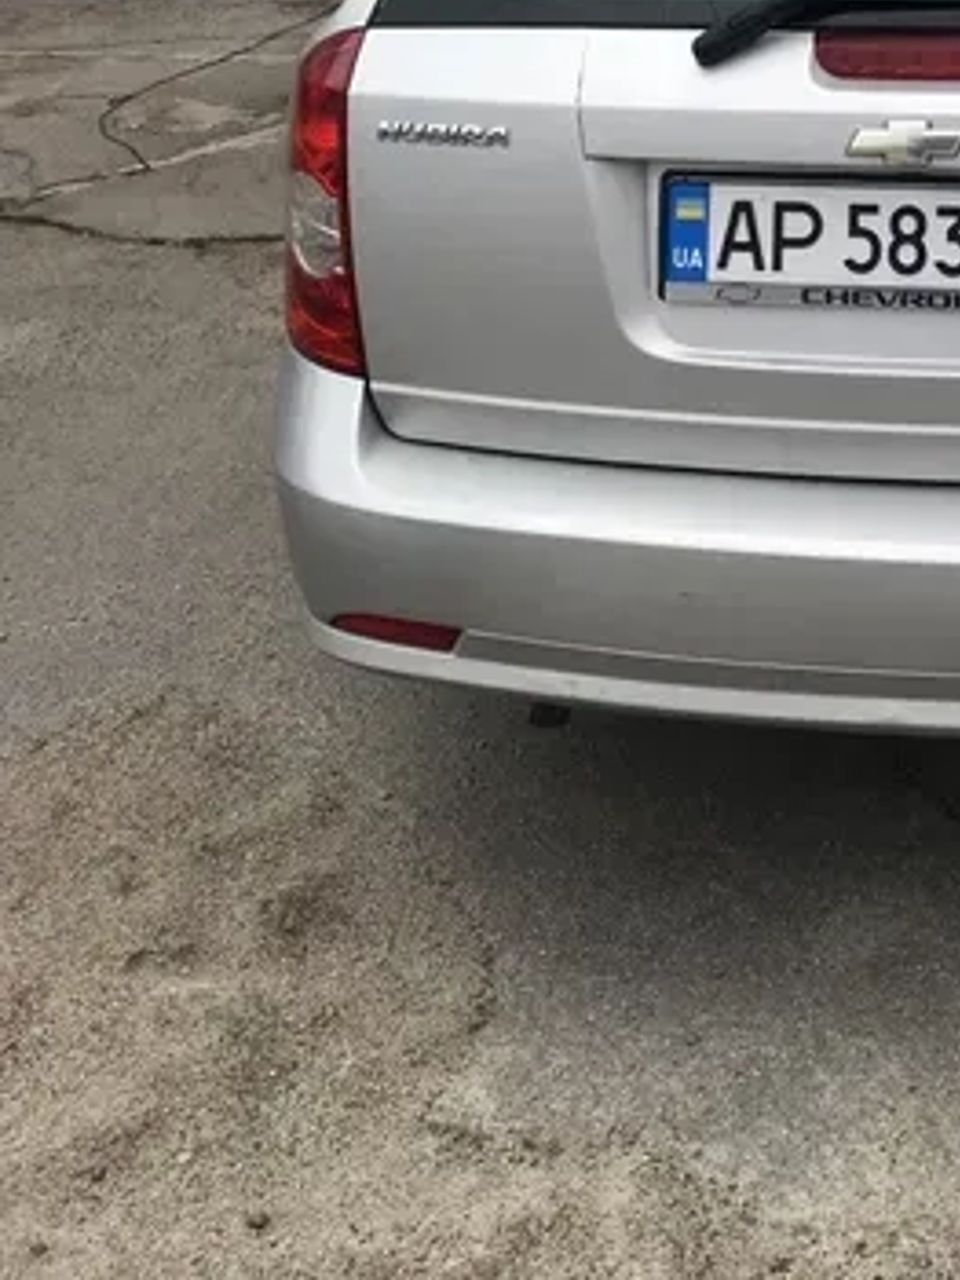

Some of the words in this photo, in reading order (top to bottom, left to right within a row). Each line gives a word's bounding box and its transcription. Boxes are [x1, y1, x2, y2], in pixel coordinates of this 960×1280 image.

[377, 120, 511, 149] NUBIRA
[716, 200, 823, 272] AP
[672, 247, 704, 269] UA
